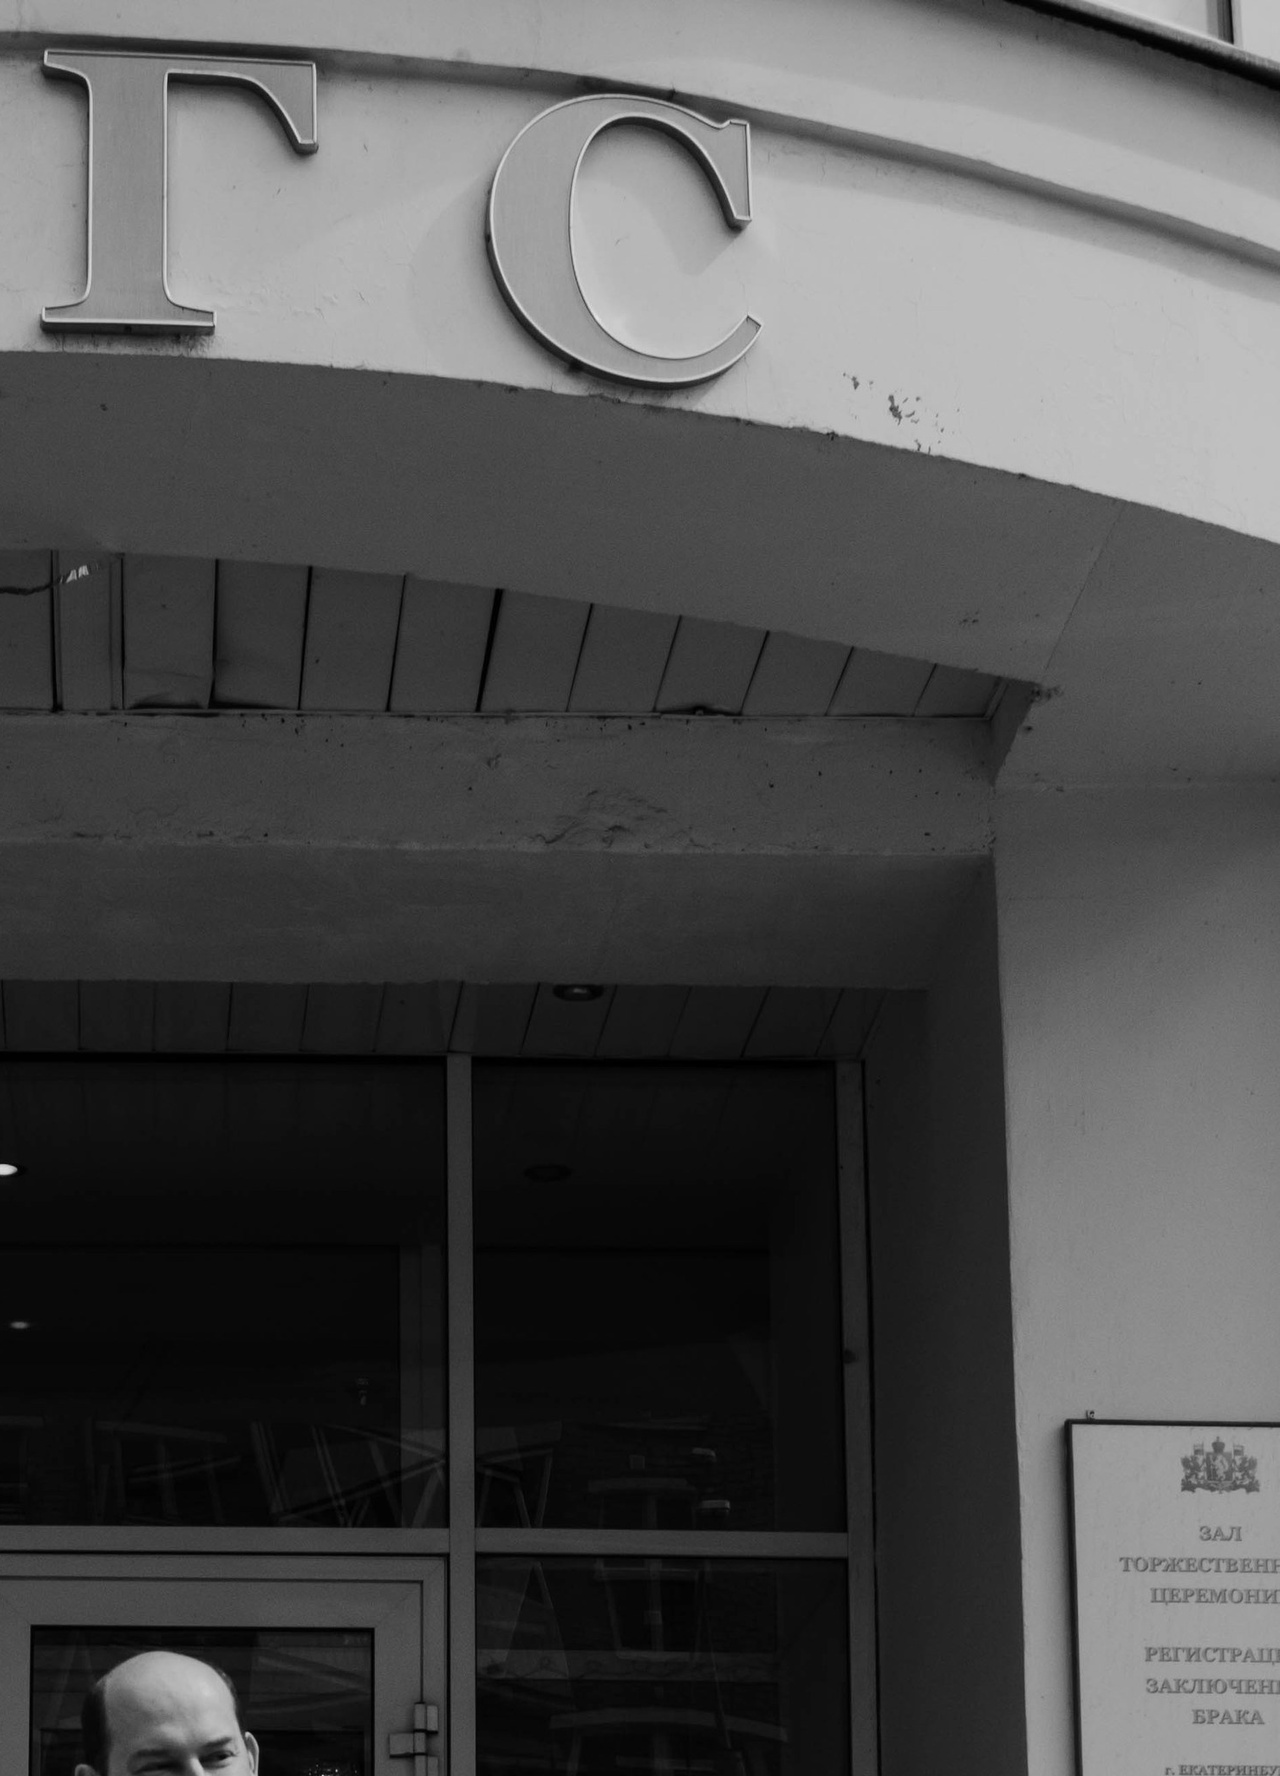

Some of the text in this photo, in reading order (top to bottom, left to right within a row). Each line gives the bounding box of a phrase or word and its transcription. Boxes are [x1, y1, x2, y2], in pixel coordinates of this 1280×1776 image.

[1198, 1525, 1243, 1542] ЗАЛ
[1144, 1646, 1280, 1666] РЕГИСТРАЦ
[1145, 1678, 1280, 1695] ЗАКЛЮЧЕН
[1191, 1708, 1266, 1725] БРАКА
[1178, 1764, 1280, 1776] ЕКАТЕРИНБУ
